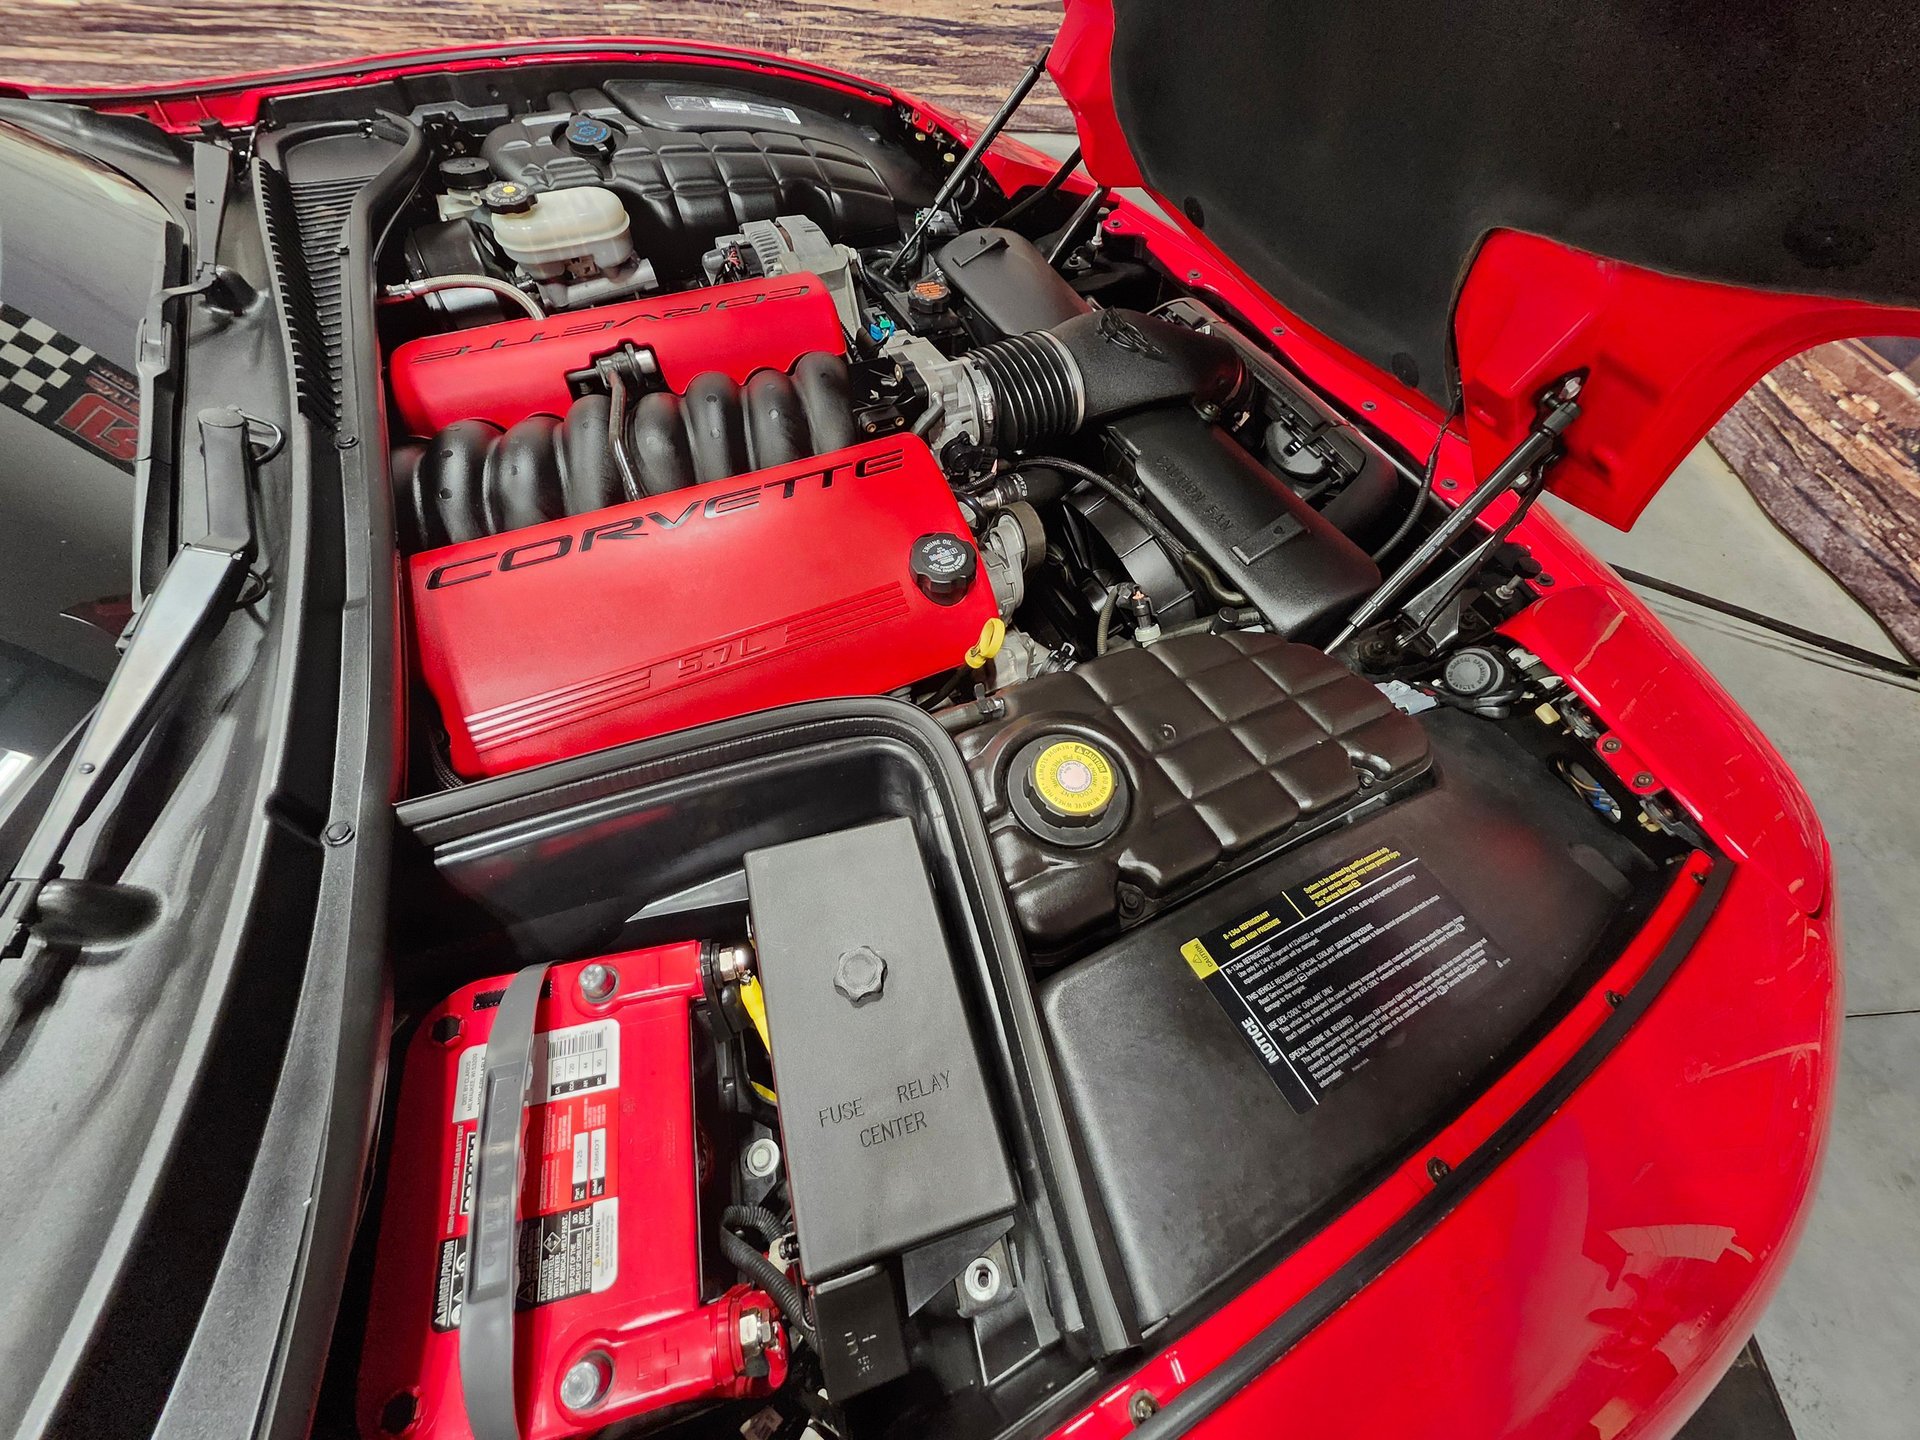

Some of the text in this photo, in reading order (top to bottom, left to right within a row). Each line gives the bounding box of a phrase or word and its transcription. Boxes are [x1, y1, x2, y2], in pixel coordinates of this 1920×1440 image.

[412, 285, 810, 364] CORVETTE
[1156, 455, 1233, 532] CAUTION FAN
[425, 448, 905, 590] CORVETTE
[922, 539, 941, 554] ENGINE
[678, 638, 766, 678] 5.7L
[1084, 748, 1107, 773] CAUTION
[1044, 786, 1055, 798] HOT
[1054, 799, 1072, 809] WHEN
[1061, 788, 1093, 799] COOLANT
[1074, 797, 1100, 810] REMOVE
[1196, 944, 1213, 967] CAUTION
[1226, 945, 1273, 974] R-134a REFRIGERANT
[1246, 991, 1259, 1002] THIS
[1256, 981, 1276, 996] VEHICLE
[1274, 969, 1297, 985] REQUIRES
[1299, 956, 1318, 970] SPECIAL
[1316, 945, 1337, 960] COOLANT
[1335, 936, 1353, 949] SERVICE
[1267, 1021, 1278, 1030] USE
[1301, 992, 1324, 1009] COOLANT
[1321, 986, 1334, 996] ONLY
[1242, 1016, 1279, 1064] NOTICE
[1289, 1015, 1354, 1061] SPECIAL ENGINE OIL REQUIRED
[555, 1086, 561, 1094] CA
[818, 1070, 950, 1128] FUSE RELAY
[455, 1124, 464, 1152] BATTERY
[860, 1110, 928, 1148] CENTER
[573, 1213, 578, 1224] DO
[437, 1239, 454, 1314] DANGER/POISON
[547, 1254, 555, 1300] IMMEDIATELY
[576, 1262, 581, 1270] OF
